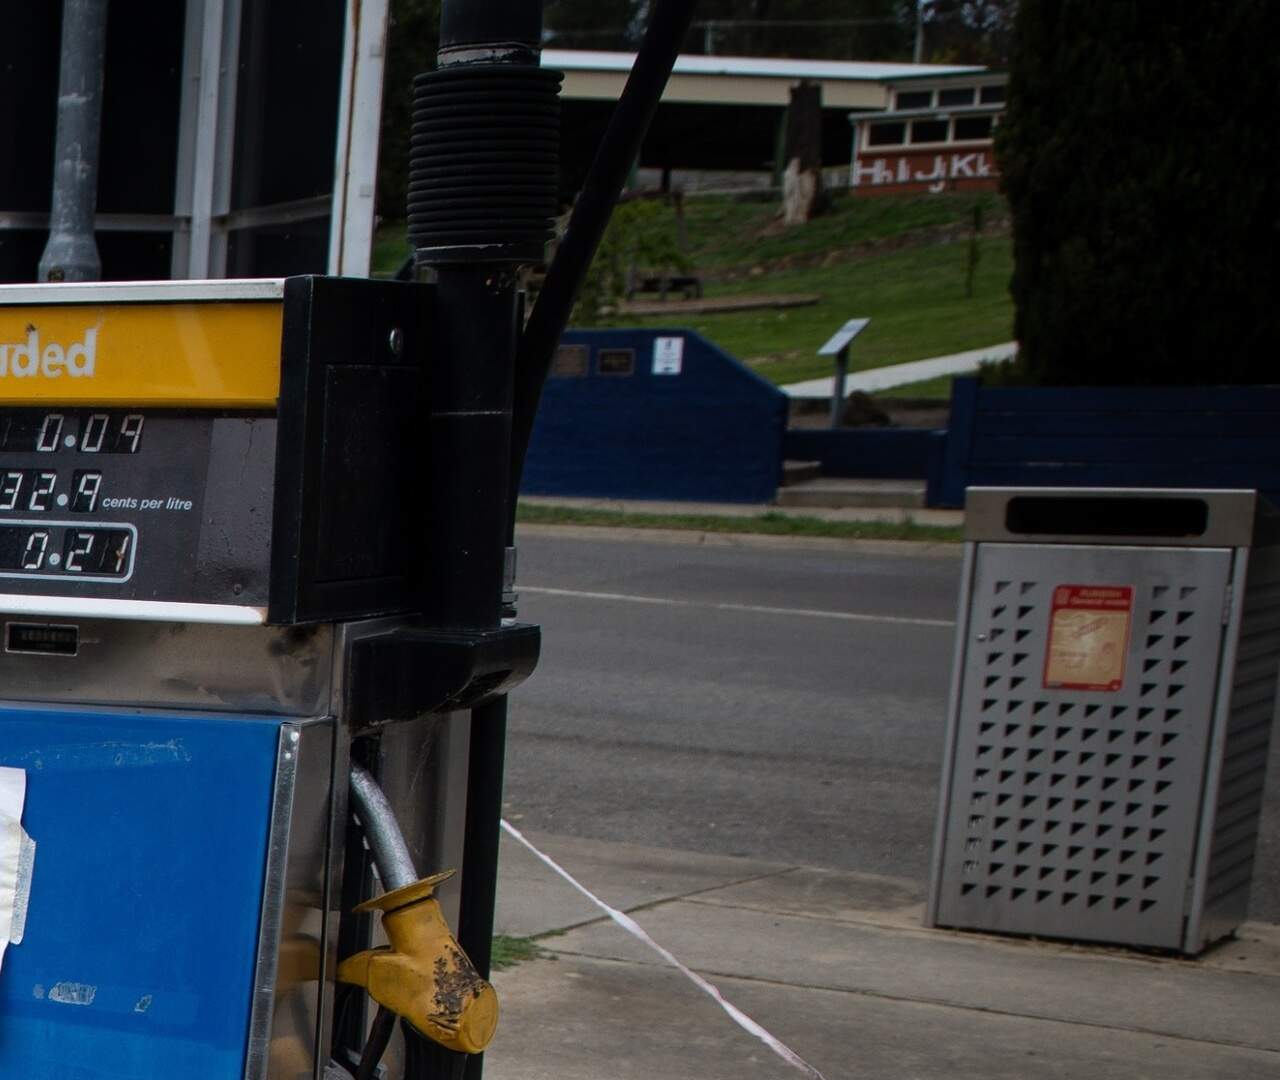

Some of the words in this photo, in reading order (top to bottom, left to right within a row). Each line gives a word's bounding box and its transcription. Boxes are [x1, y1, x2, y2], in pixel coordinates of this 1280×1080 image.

[102, 497, 138, 510] cents
[140, 499, 162, 510] per
[167, 498, 192, 510] litre
